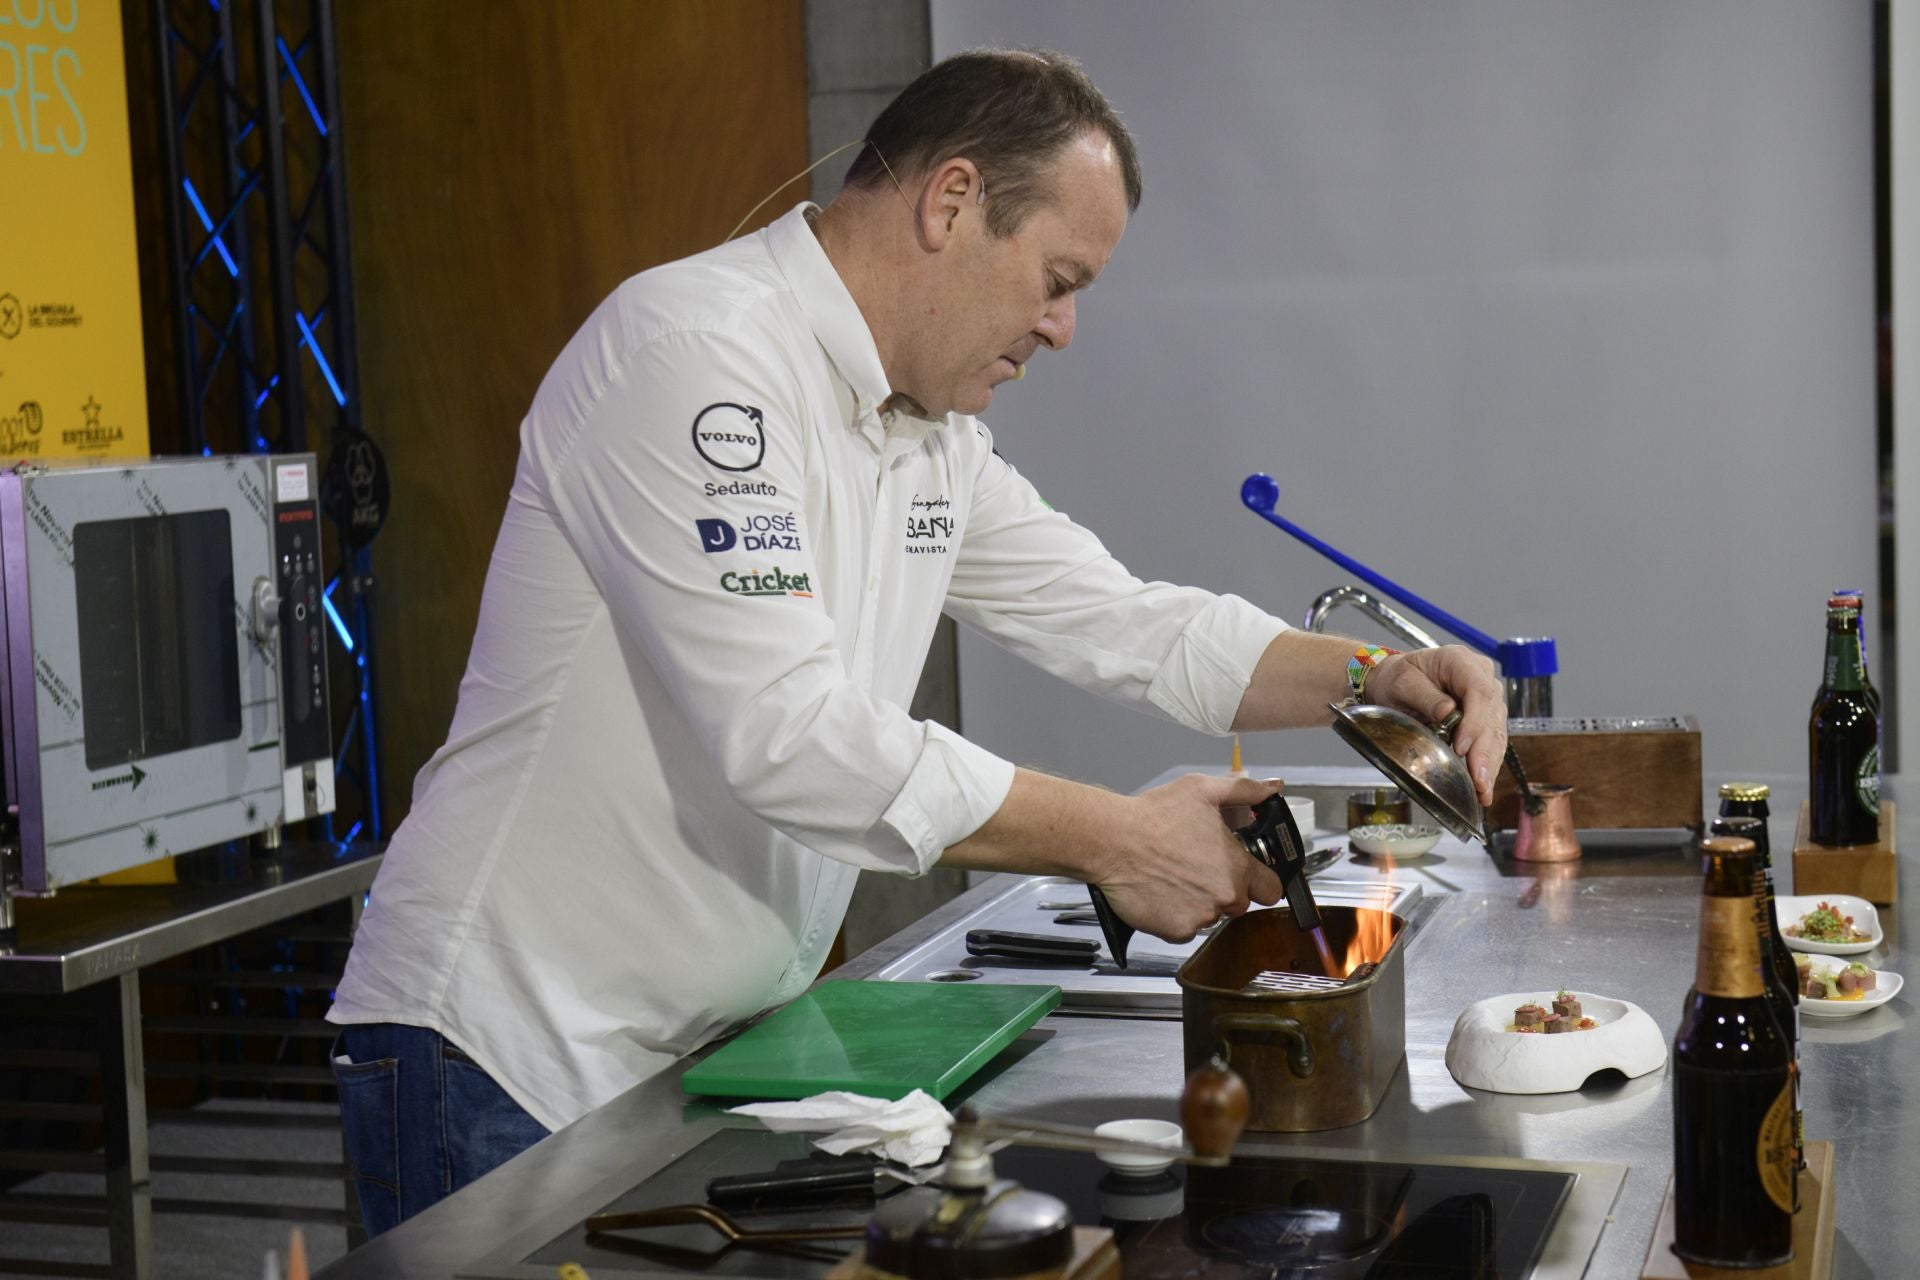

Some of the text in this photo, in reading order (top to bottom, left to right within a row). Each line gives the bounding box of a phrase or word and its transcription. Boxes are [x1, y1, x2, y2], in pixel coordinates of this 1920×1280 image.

[62, 427, 124, 445] ESTRELLA
[699, 432, 757, 446] VOLVO
[704, 481, 777, 497] Sedauto
[741, 512, 797, 532] JOSÉ
[720, 566, 812, 593] Cricket
